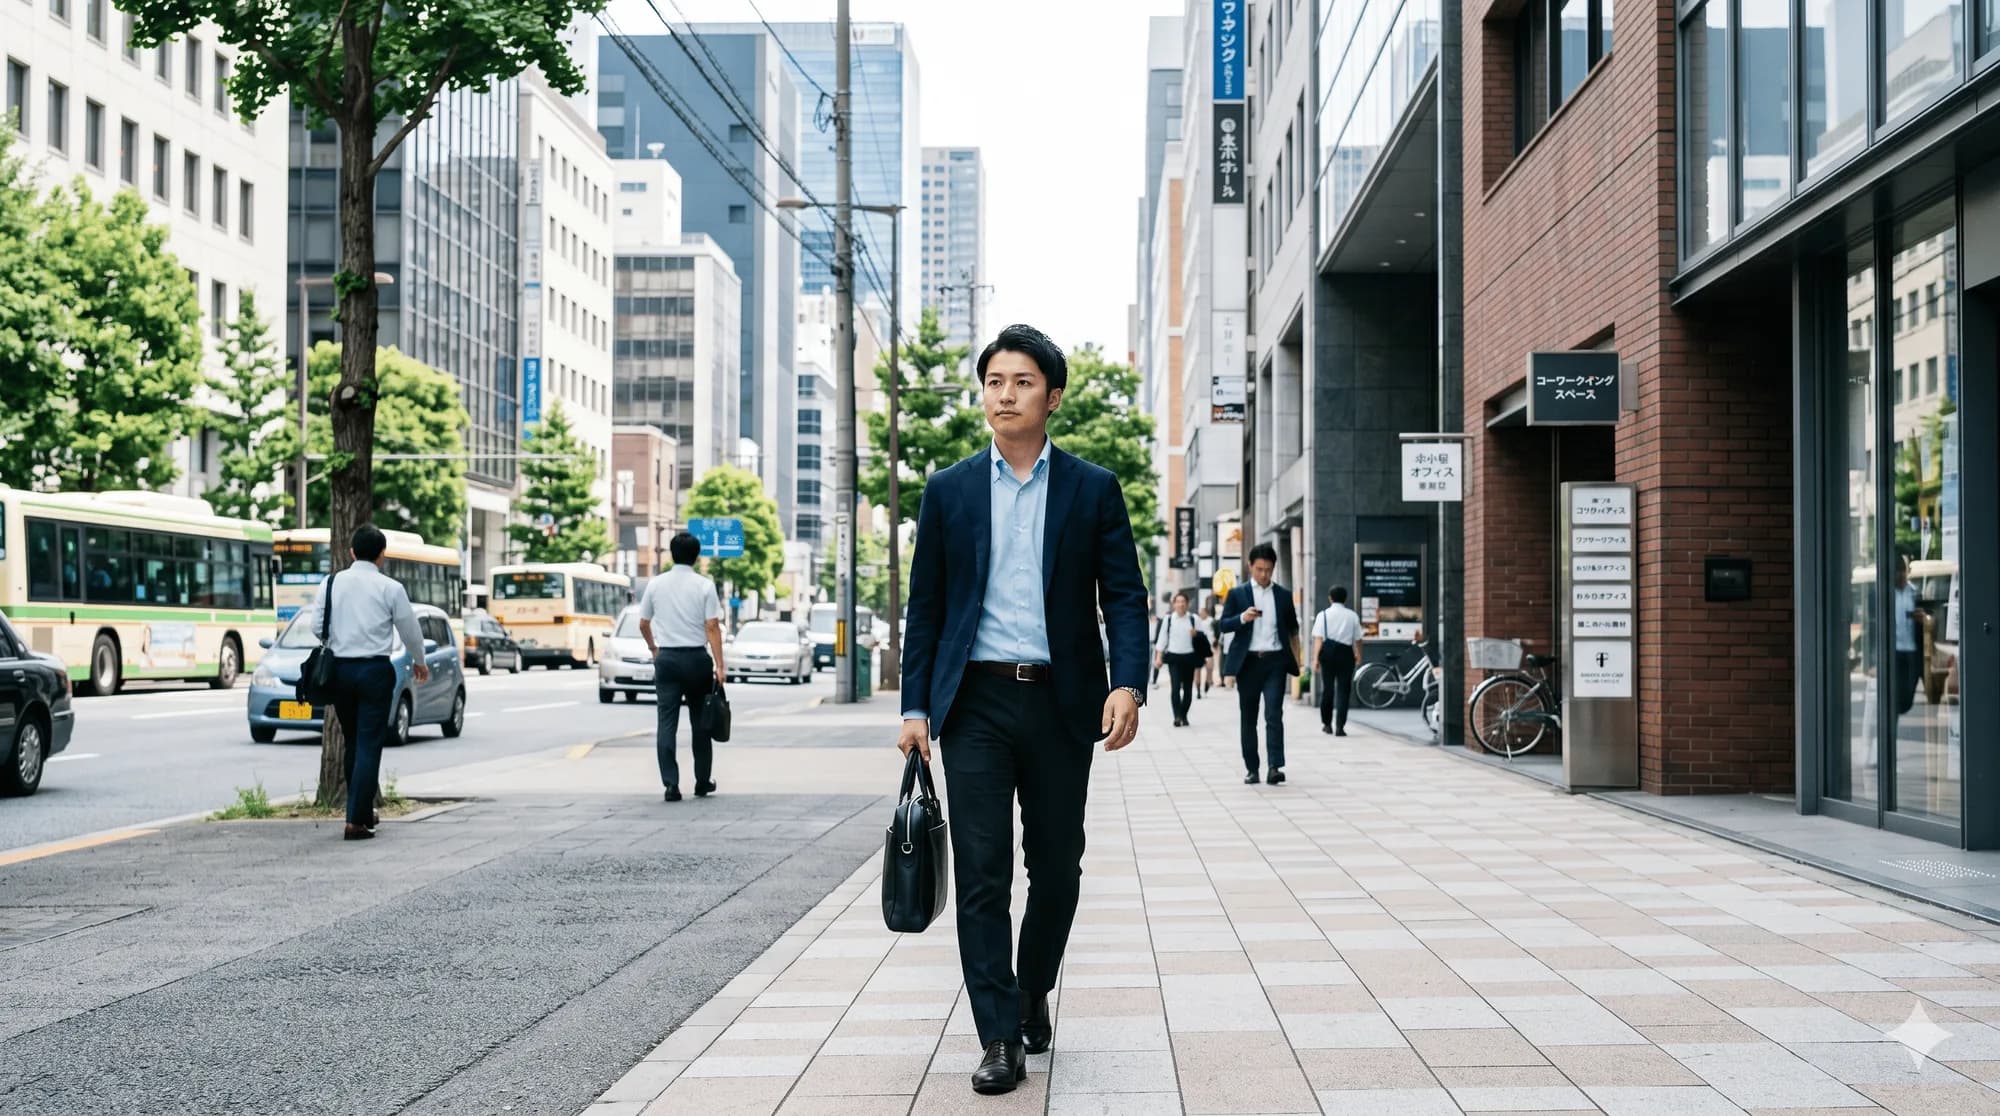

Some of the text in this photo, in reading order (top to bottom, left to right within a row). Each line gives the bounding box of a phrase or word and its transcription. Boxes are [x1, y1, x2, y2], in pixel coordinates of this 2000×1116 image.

[1554, 389, 1596, 400] スペース
[1411, 467, 1455, 478] オフィス
